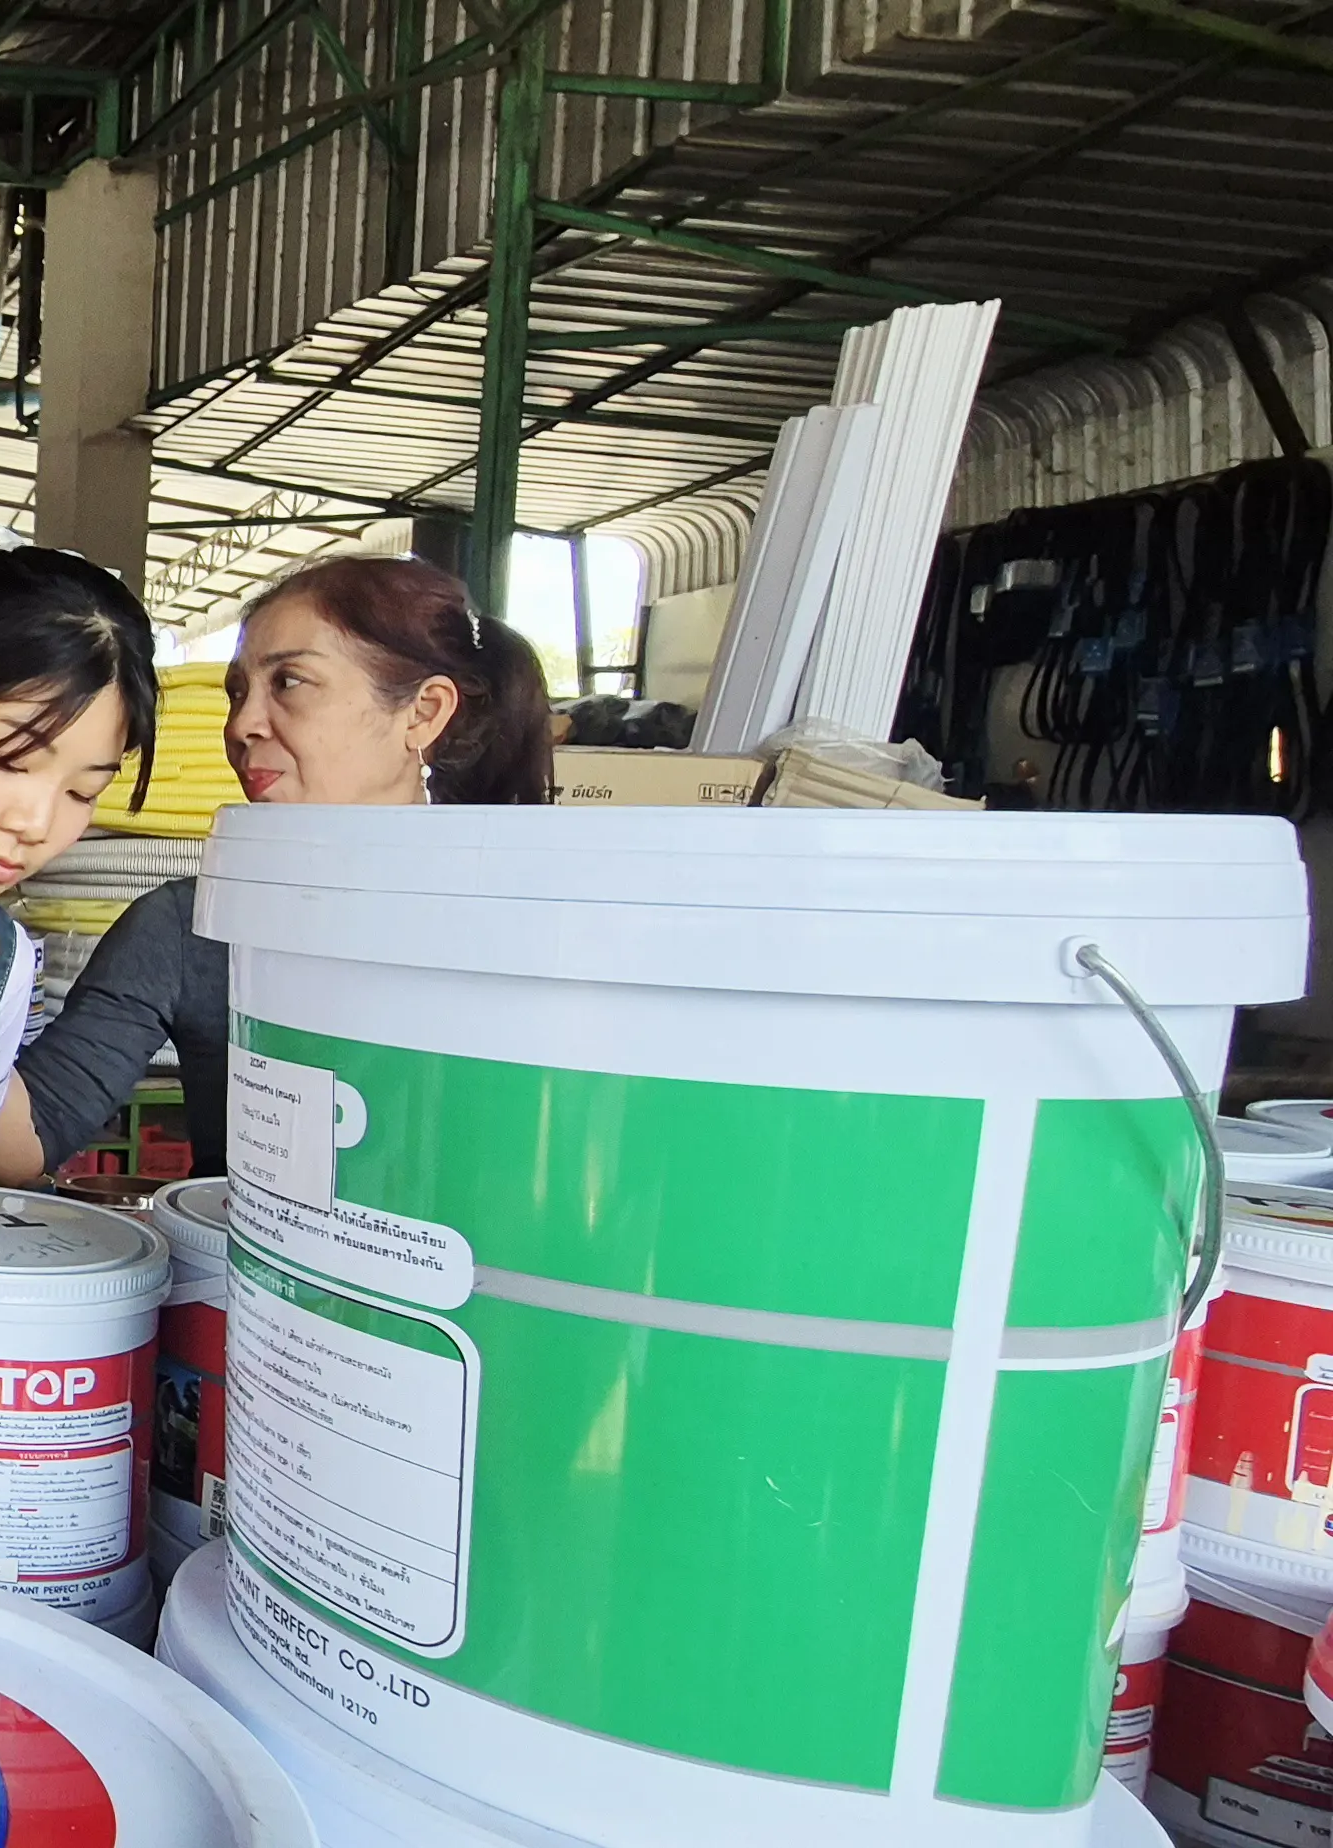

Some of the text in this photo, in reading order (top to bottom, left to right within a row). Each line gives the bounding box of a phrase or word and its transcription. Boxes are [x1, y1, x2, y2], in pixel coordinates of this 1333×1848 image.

[333, 1231, 445, 1271] พร้อมผสมสารป้องกัน
[12, 1585, 40, 1594] PAINT
[43, 1583, 79, 1594] PERFECT
[235, 1562, 260, 1603] PAINT
[265, 1595, 329, 1655] PERFECT
[340, 1693, 378, 1725] 12170
